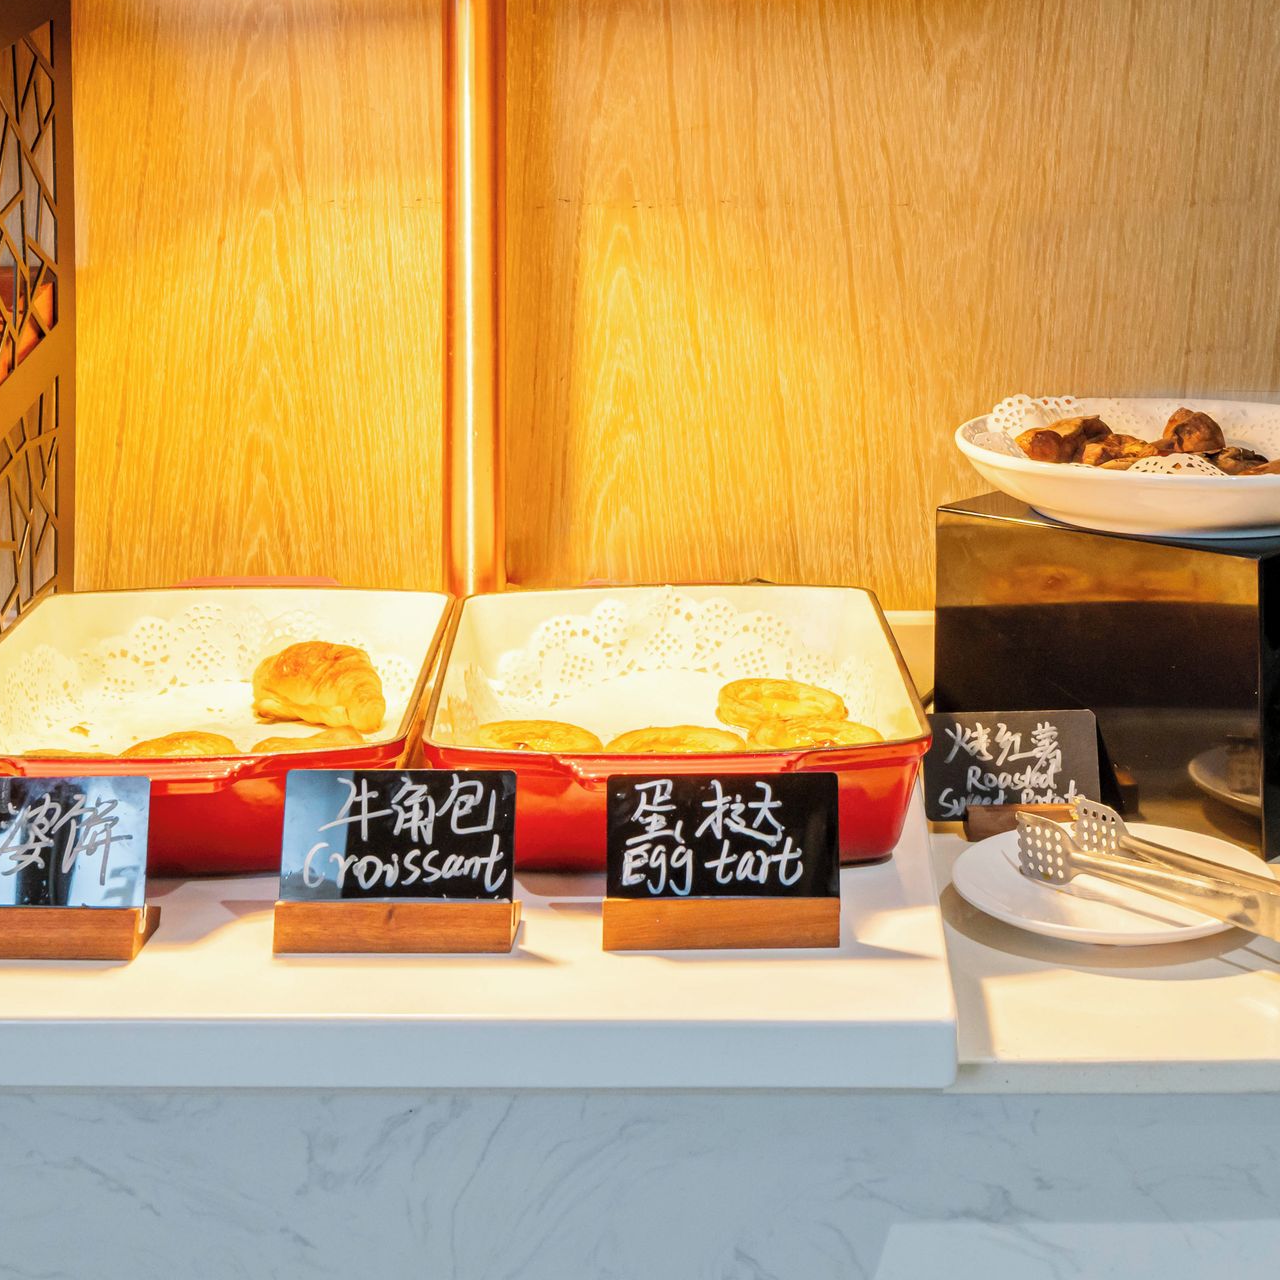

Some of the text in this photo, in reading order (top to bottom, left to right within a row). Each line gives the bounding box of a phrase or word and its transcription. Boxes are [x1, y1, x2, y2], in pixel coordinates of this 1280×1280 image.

[966, 765, 1057, 792] Roasted
[1021, 780, 1086, 805] Potat
[318, 774, 496, 844] 牛角包
[303, 834, 506, 892] Croissant
[622, 837, 803, 895] Egg tart
